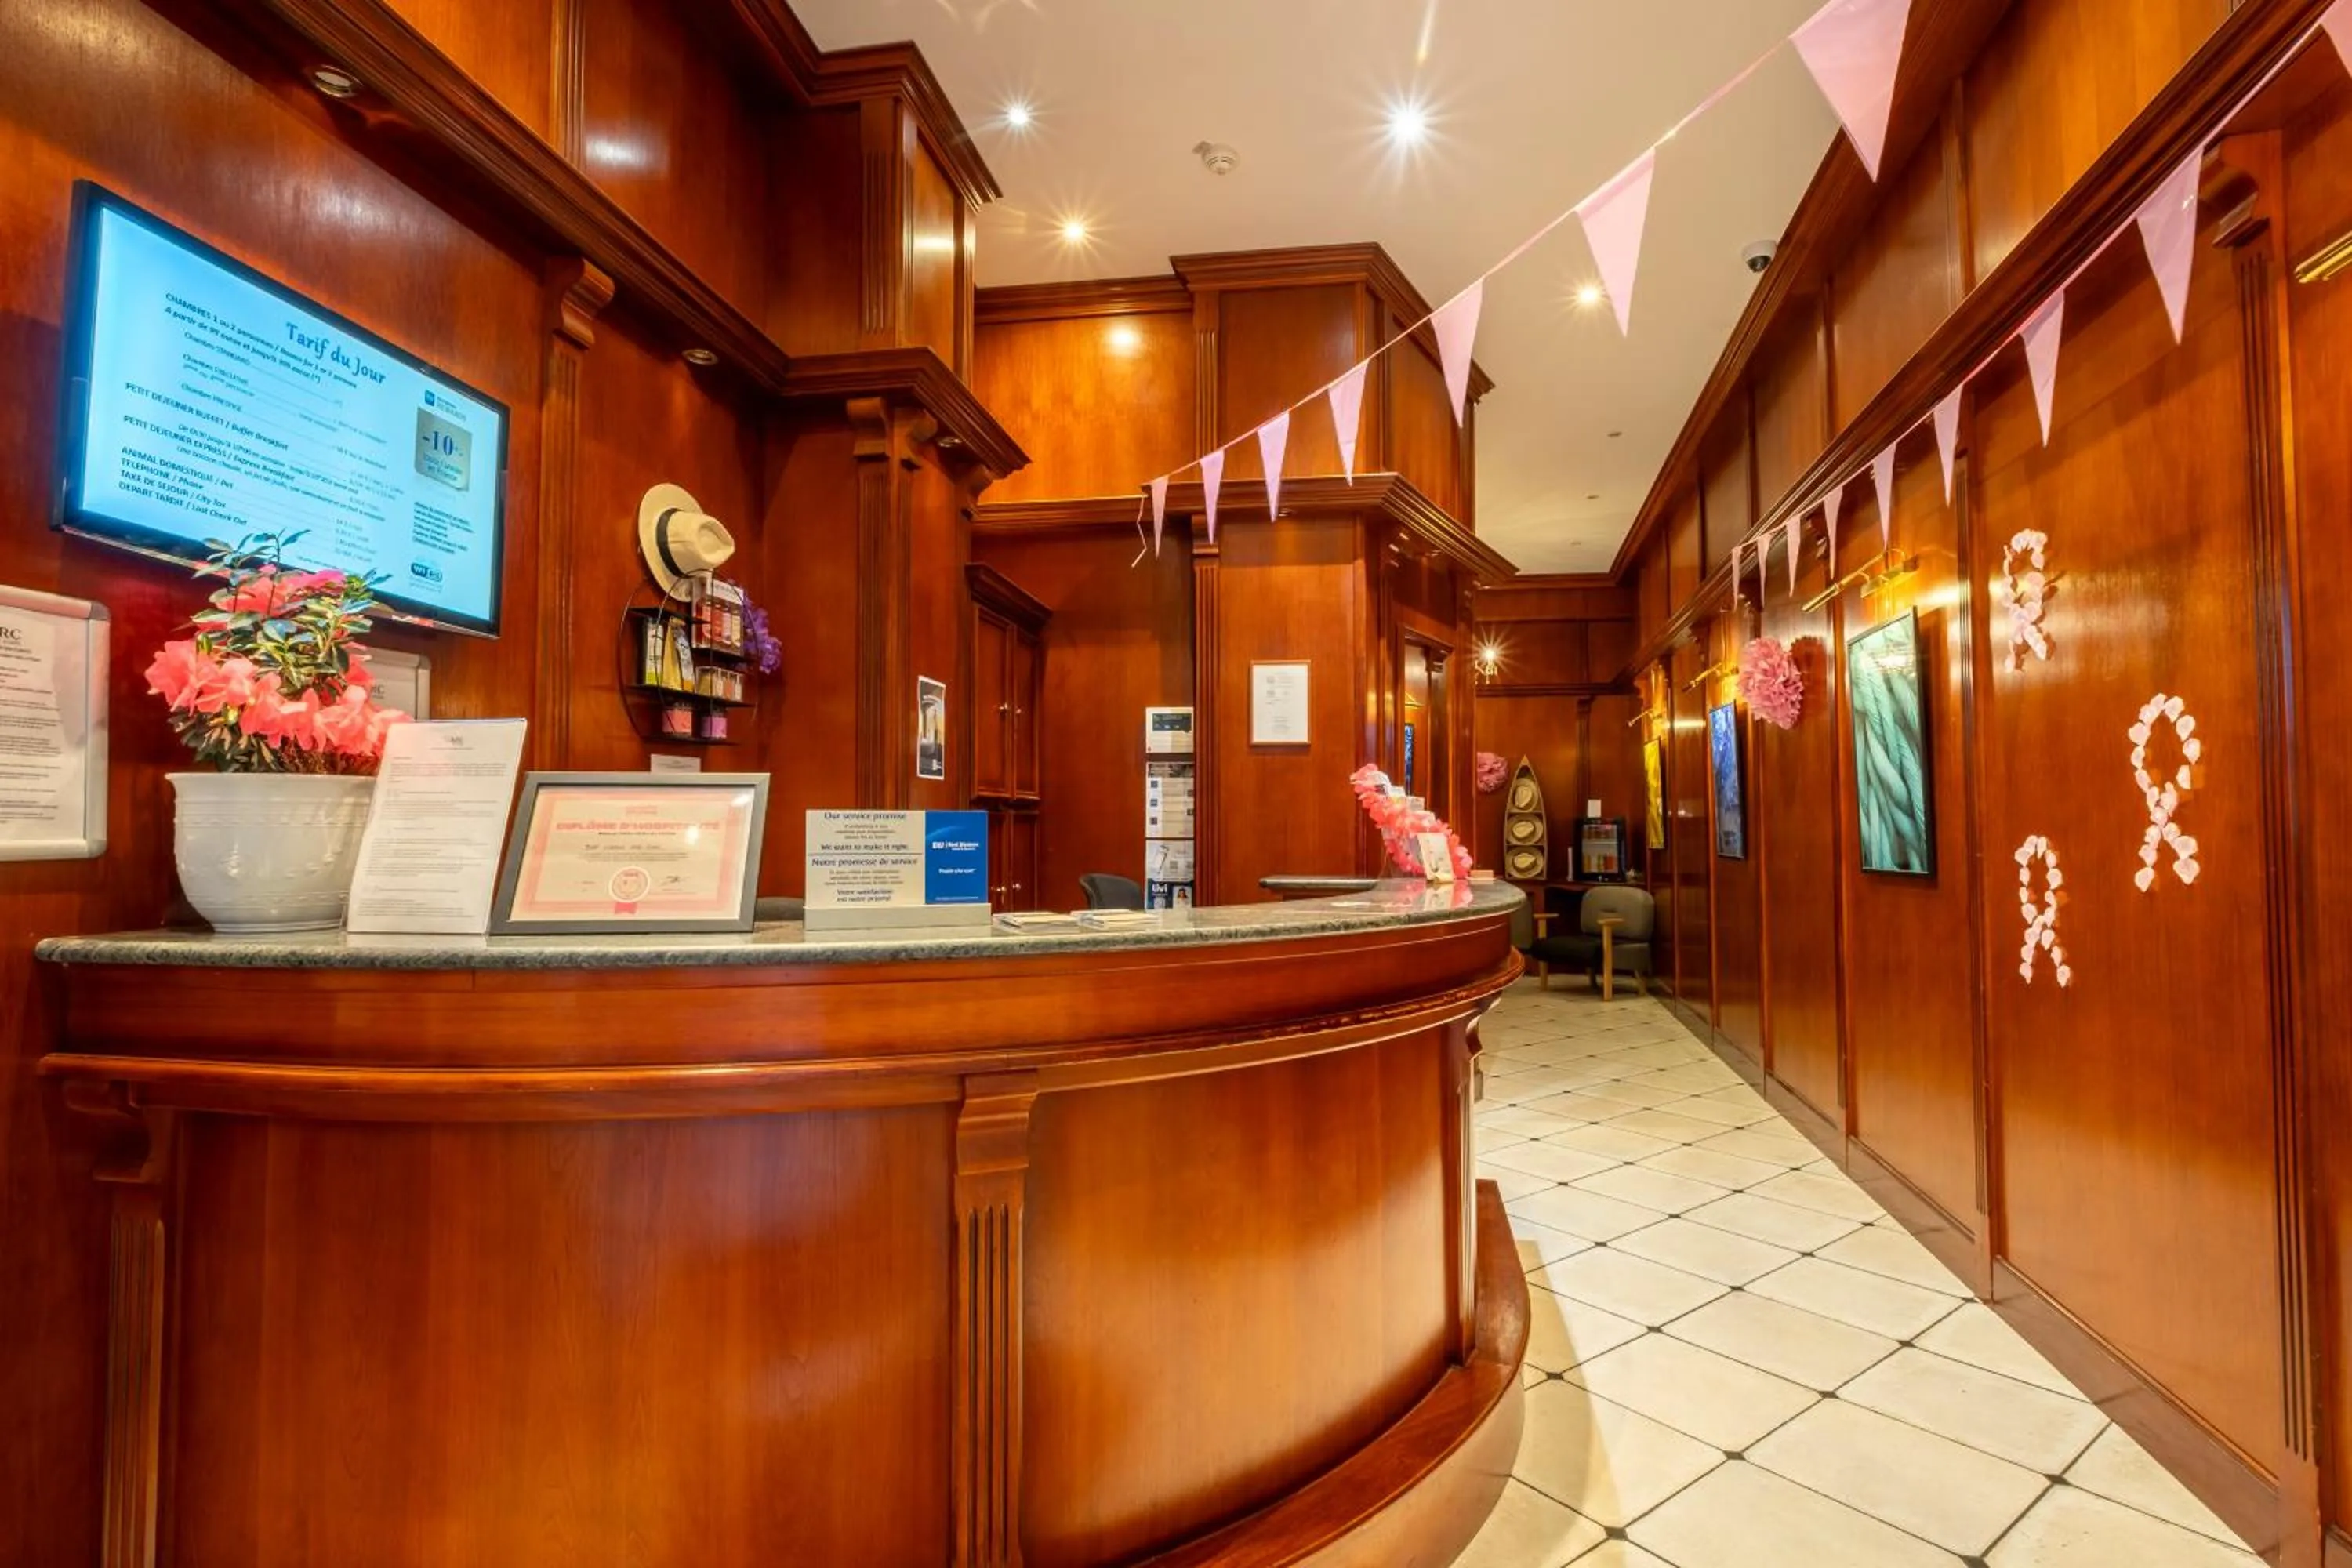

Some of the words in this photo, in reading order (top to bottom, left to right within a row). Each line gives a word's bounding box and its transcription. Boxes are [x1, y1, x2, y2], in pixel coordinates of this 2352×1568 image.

[286, 321, 329, 359] Tarif
[331, 346, 350, 368] du
[352, 358, 386, 383] Jour
[126, 383, 149, 397] PETIT
[124, 416, 147, 429] PETIT
[122, 447, 157, 464] ANIMAL
[160, 459, 212, 481] DOMESTIQUE
[122, 458, 169, 480] TELEPHONE
[119, 482, 152, 497] DEPART
[122, 470, 141, 483] TAXE
[158, 481, 188, 496] SEJOUR
